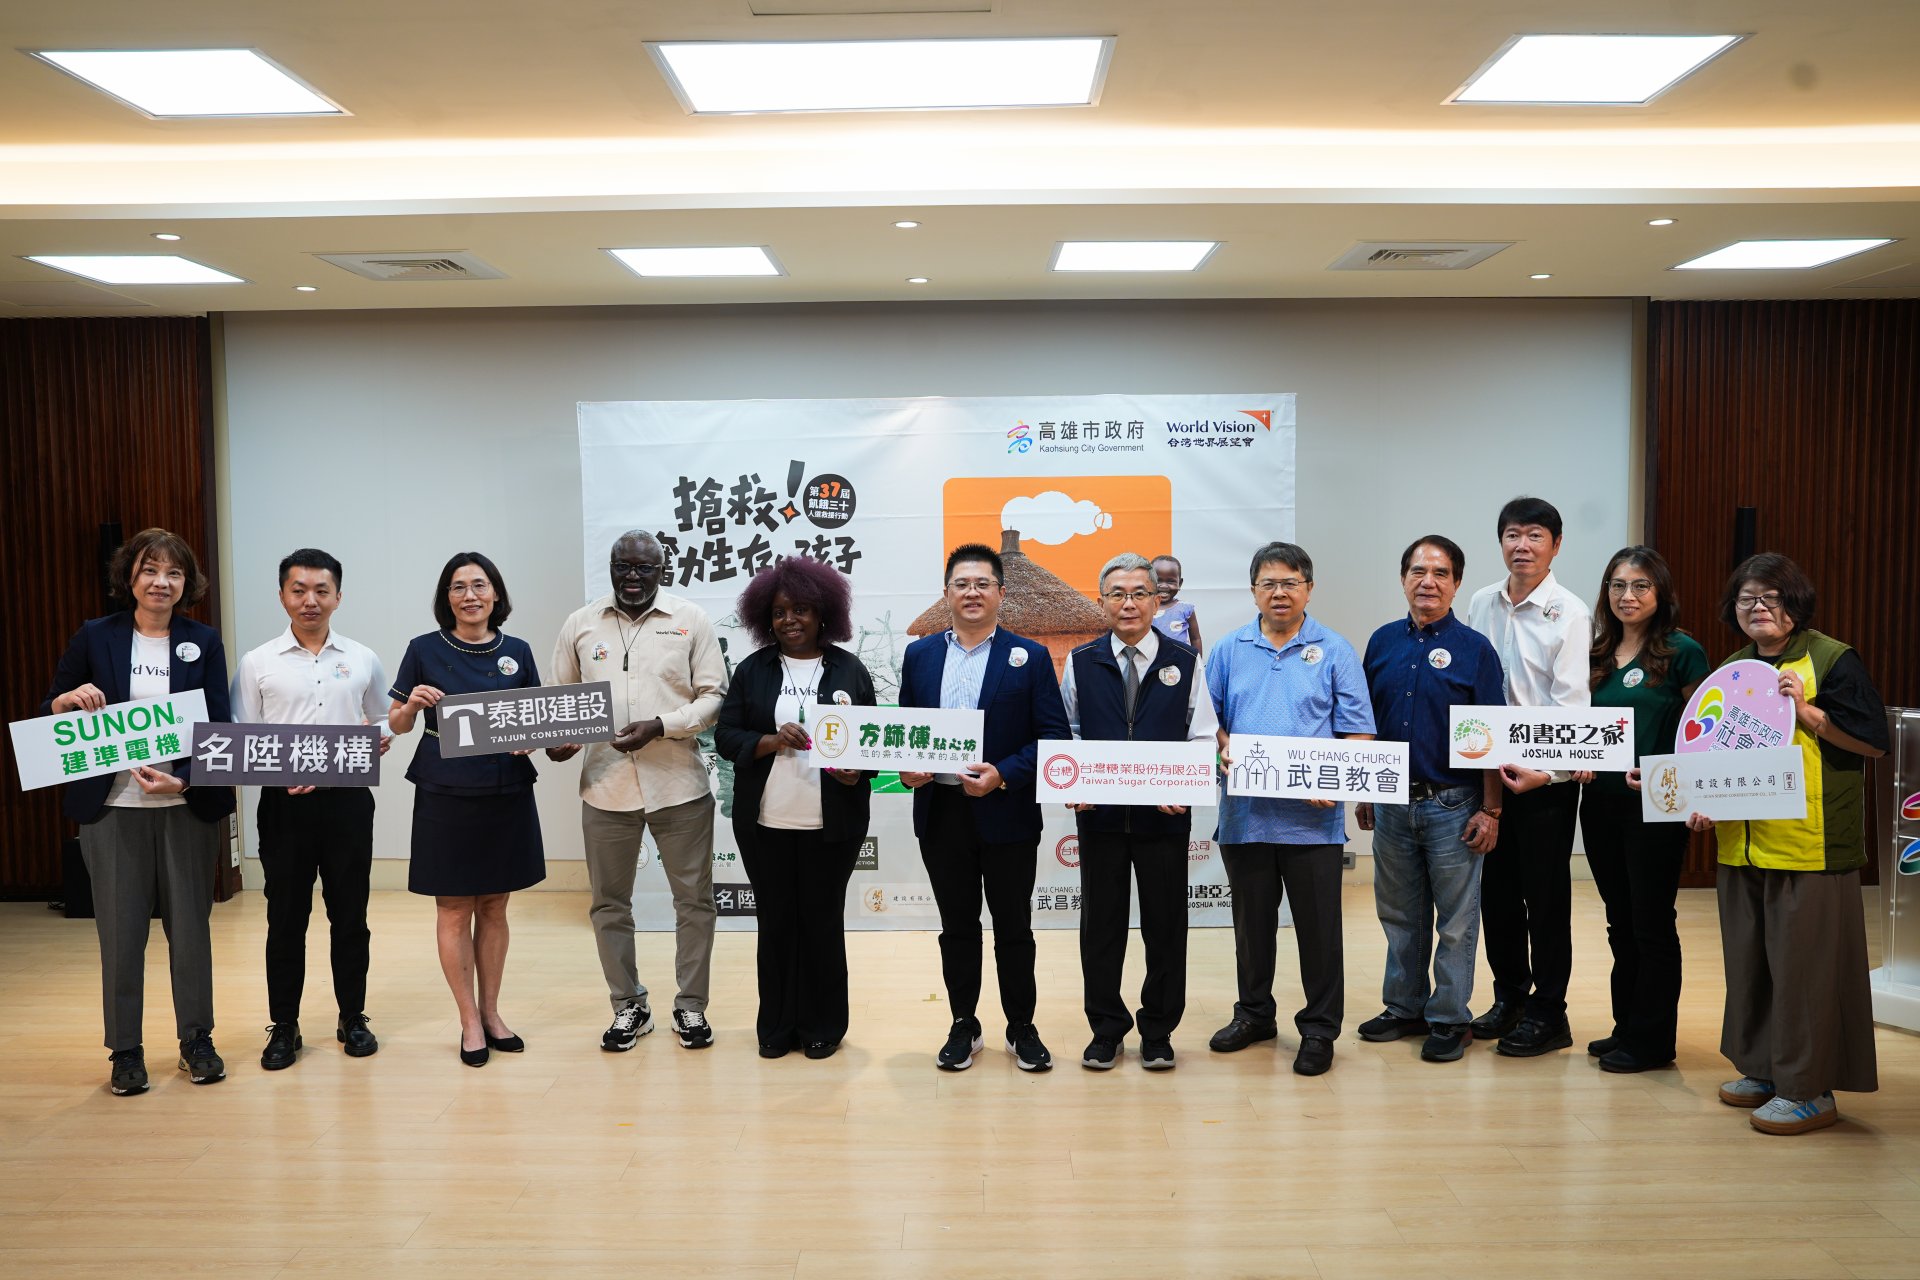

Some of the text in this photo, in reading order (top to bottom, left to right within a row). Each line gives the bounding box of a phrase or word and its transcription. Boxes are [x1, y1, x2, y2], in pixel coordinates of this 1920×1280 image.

[1039, 420, 1144, 440] 高雄市政府
[1166, 420, 1256, 433] World Vision
[1040, 443, 1144, 454] Kaohsiung City Government
[809, 481, 850, 499] 第37屆
[808, 498, 849, 511] 飢餓三十
[145, 665, 169, 677] Visi
[487, 691, 608, 729] 泰郡建設
[824, 722, 840, 741] F
[1727, 705, 1784, 746] 高雄市政府
[490, 725, 609, 744] TAIJUN CONSTRUCTION
[1509, 723, 1625, 747] 約書亞之家
[1716, 720, 1769, 750] 社會
[61, 732, 181, 776] 建準電機
[196, 732, 373, 774] 名陞機構
[1287, 749, 1401, 765] WU CHANG CHURCH
[1522, 748, 1605, 760] JOSHUA HOUSE
[1049, 765, 1072, 777] 台糖
[1080, 763, 1211, 777] 台灣糖業股份有限公司
[1286, 763, 1400, 793] 武昌教會
[1081, 777, 1210, 788] Taiwan Sugar Corporation
[1695, 774, 1776, 790] 建設有限公司
[716, 888, 757, 910] 名陞
[1037, 895, 1082, 911] 武昌教
[1188, 901, 1213, 909] JOSHUA
